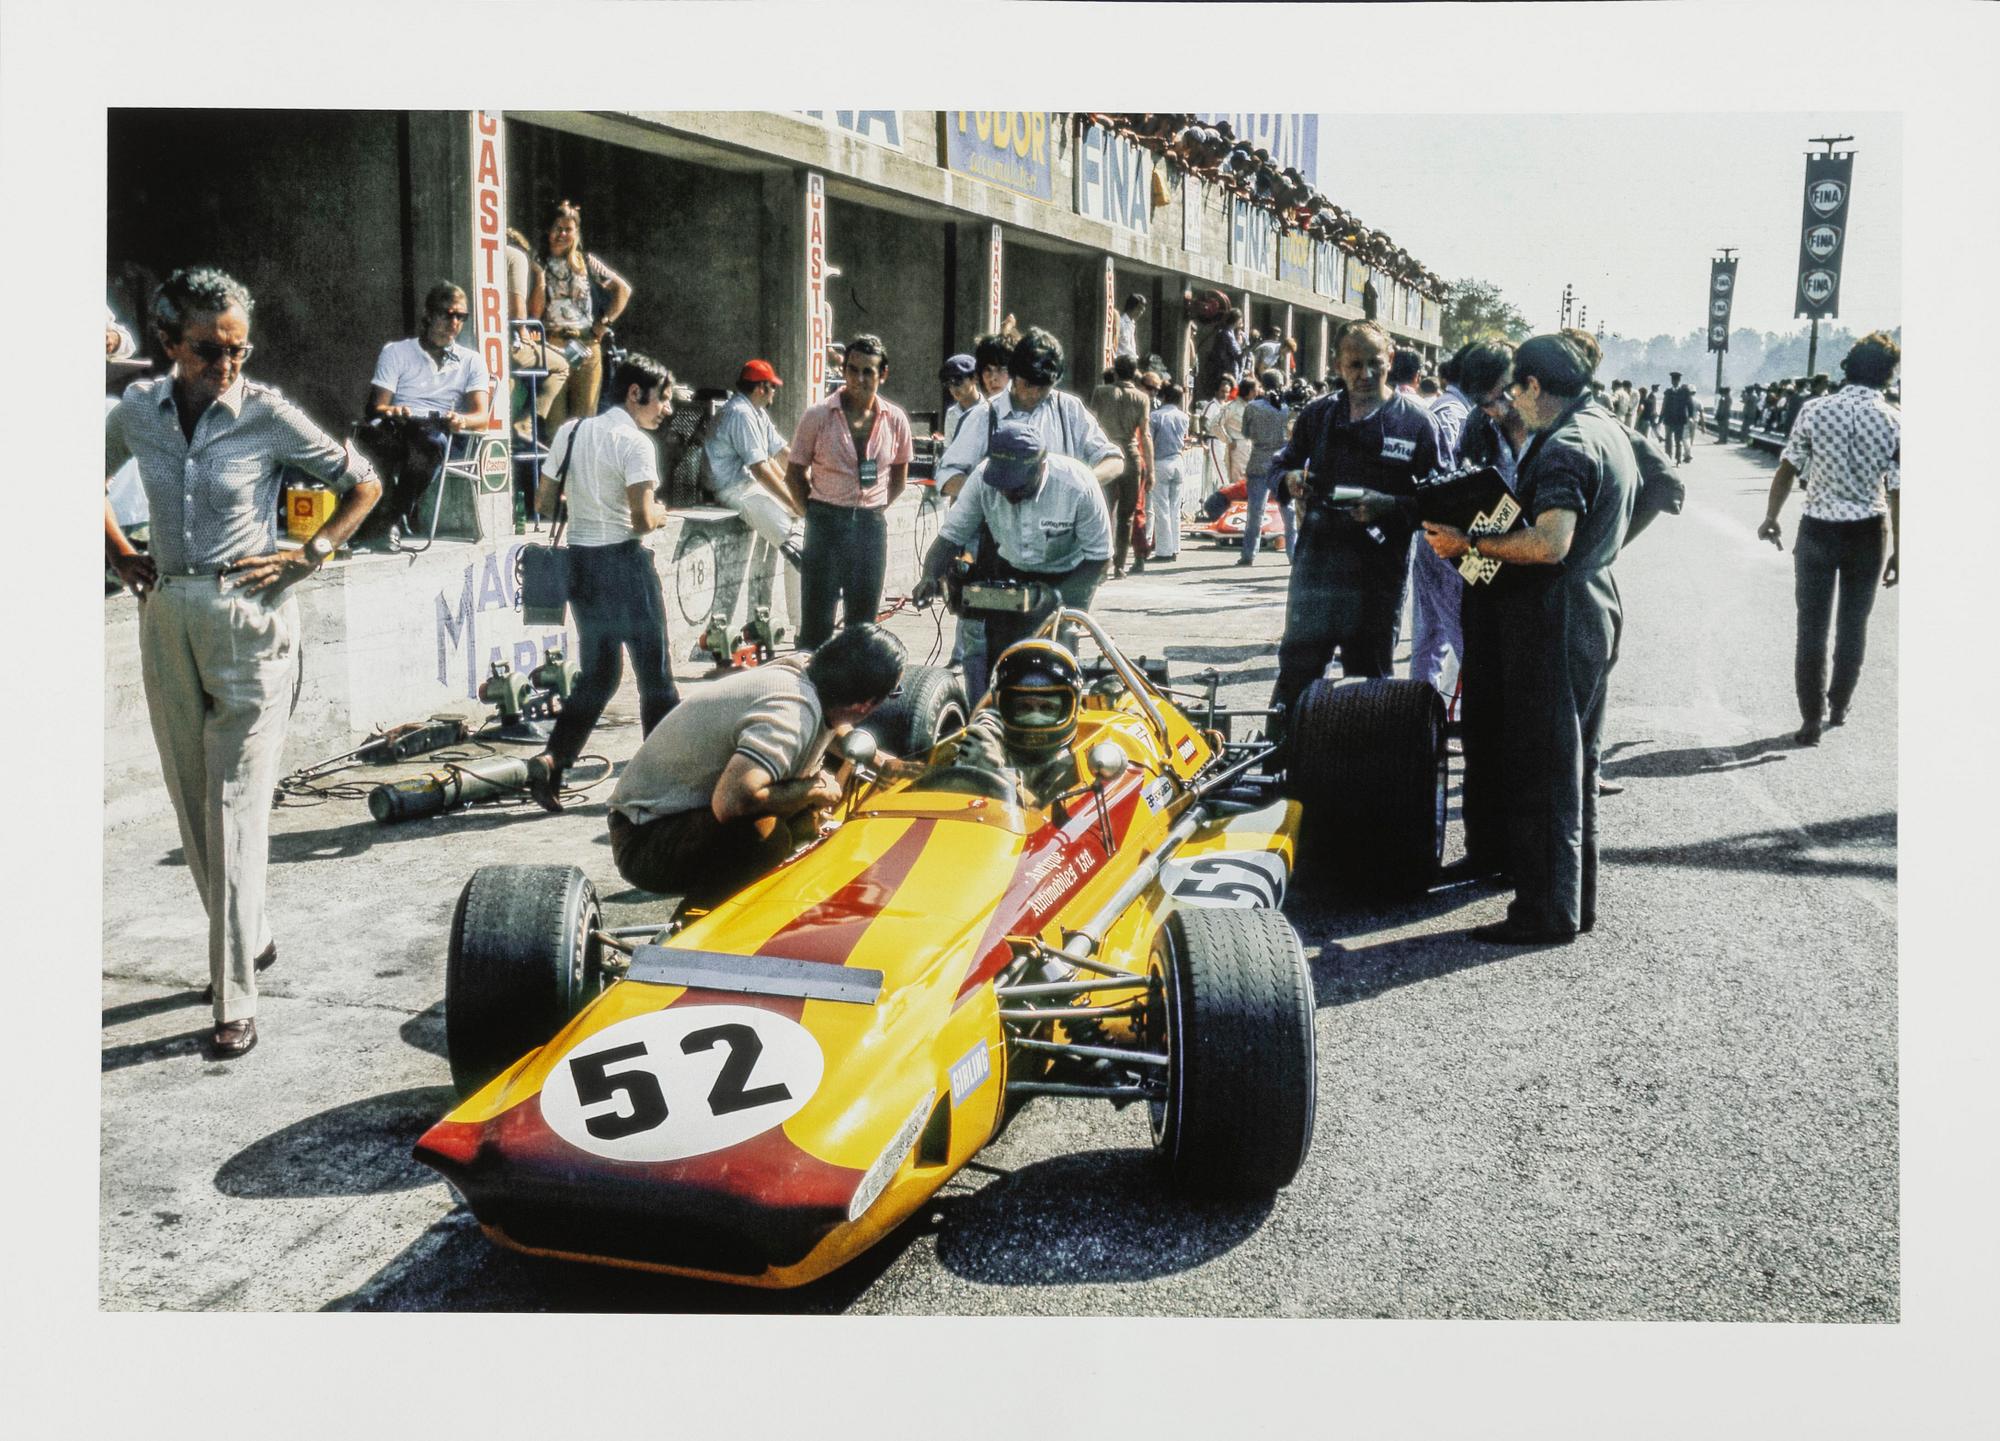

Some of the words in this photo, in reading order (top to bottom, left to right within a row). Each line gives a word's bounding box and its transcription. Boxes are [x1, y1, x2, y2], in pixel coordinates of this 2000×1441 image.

[1081, 124, 1147, 235] FINA
[1811, 189, 1839, 203] FINA
[1809, 234, 1834, 248] FINA
[1806, 279, 1830, 292] FINA
[688, 560, 705, 586] 18
[1025, 850, 1065, 882] Antique
[1027, 863, 1079, 917] Automobiles
[569, 1023, 793, 1140] 52
[953, 1046, 989, 1098] GIRLING
